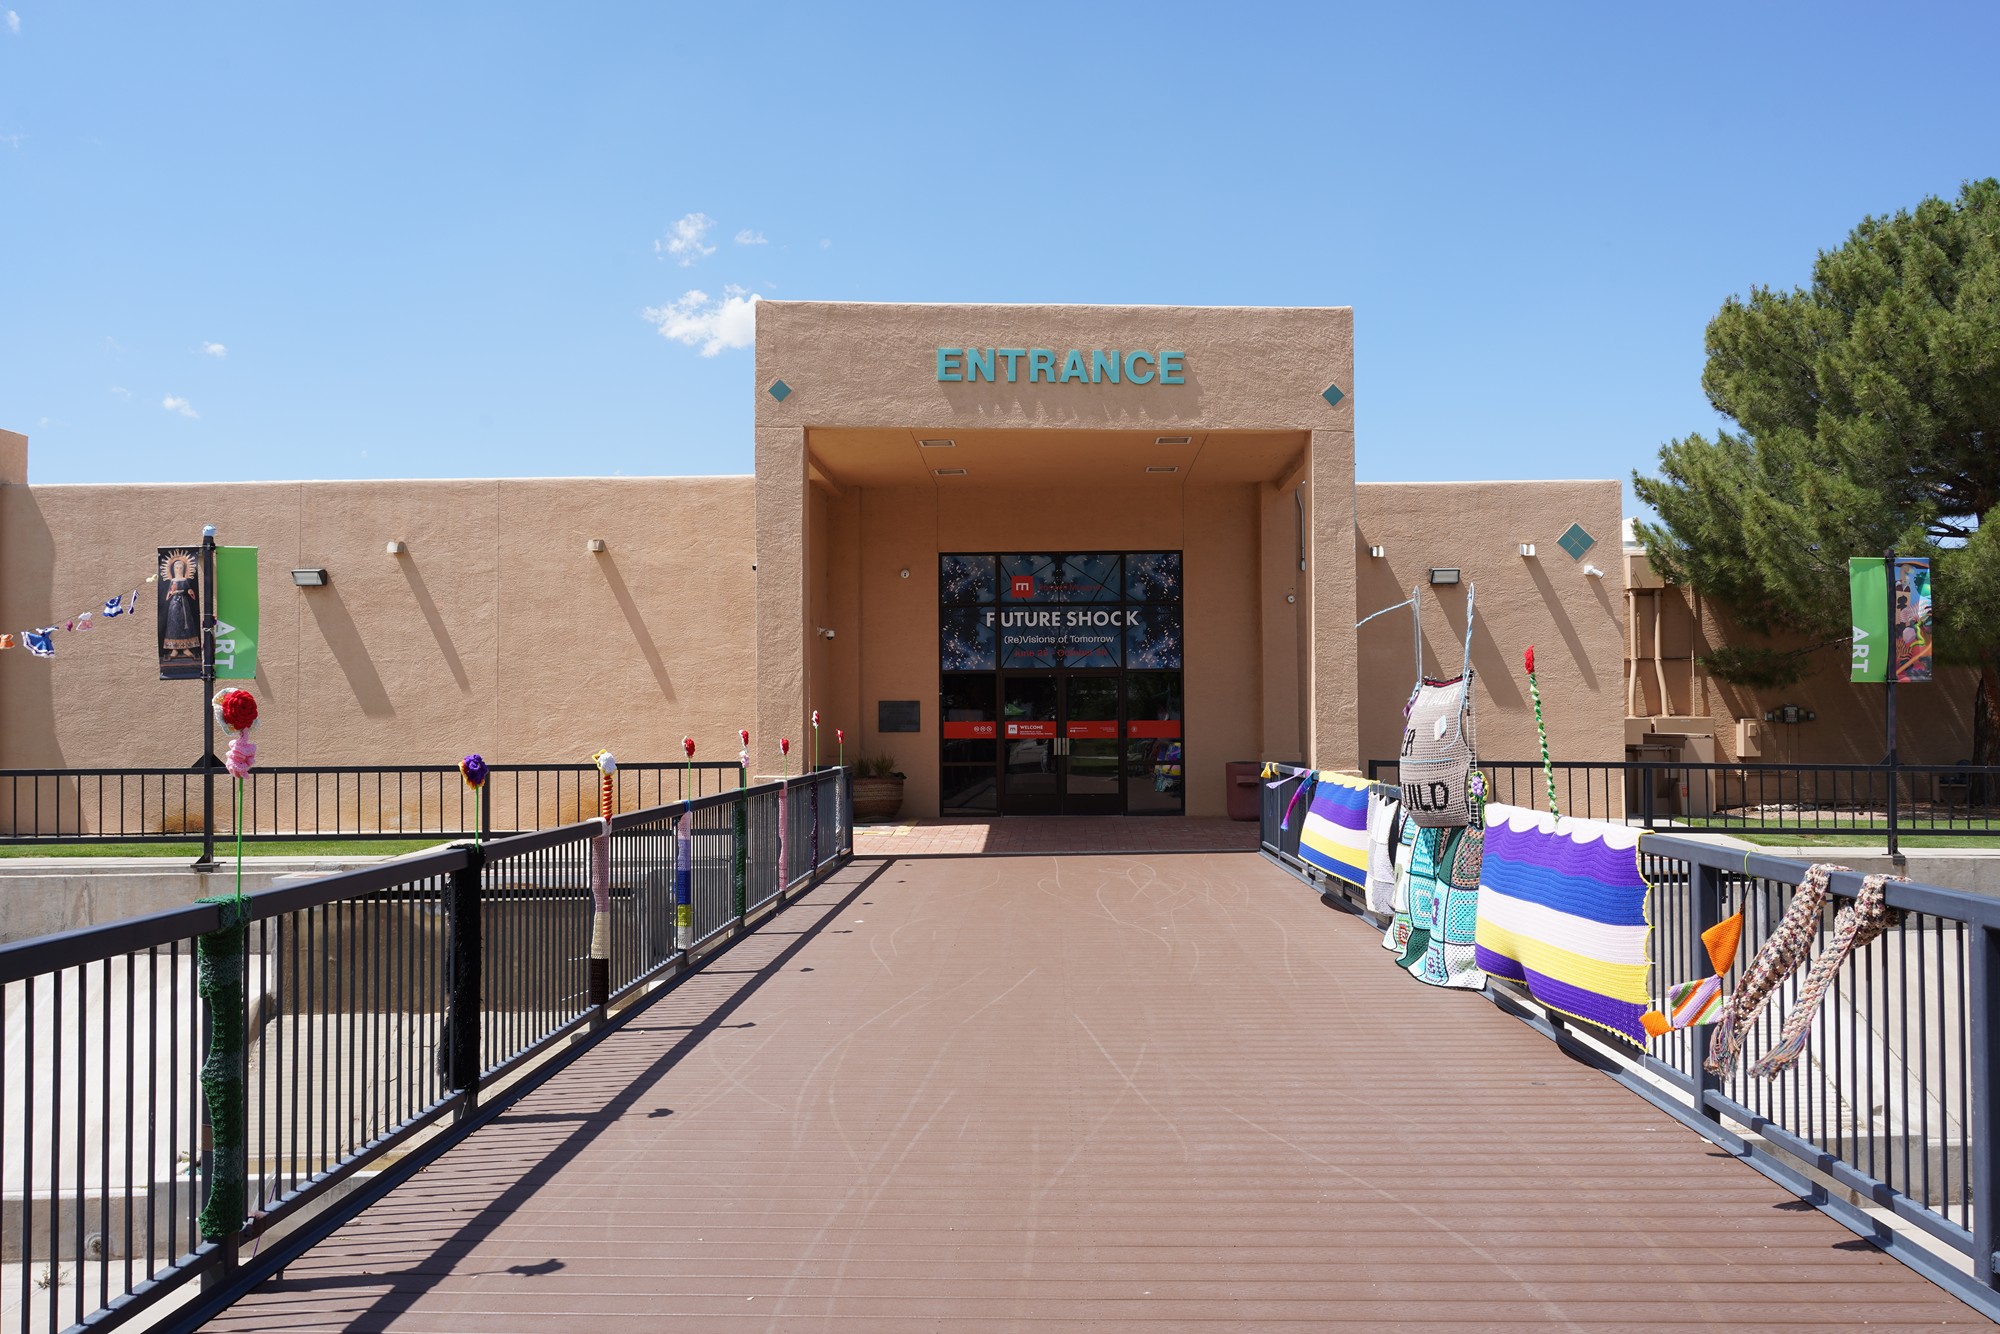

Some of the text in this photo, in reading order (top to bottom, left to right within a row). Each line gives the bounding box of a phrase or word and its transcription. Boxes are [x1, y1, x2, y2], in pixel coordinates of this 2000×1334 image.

[937, 347, 1185, 384] ENTRANCE
[986, 610, 1140, 627] FUTURE SHOCK
[214, 619, 236, 670] ART
[1004, 634, 1114, 644] (Re)Visions of Tomorrow
[1852, 625, 1870, 673] ART
